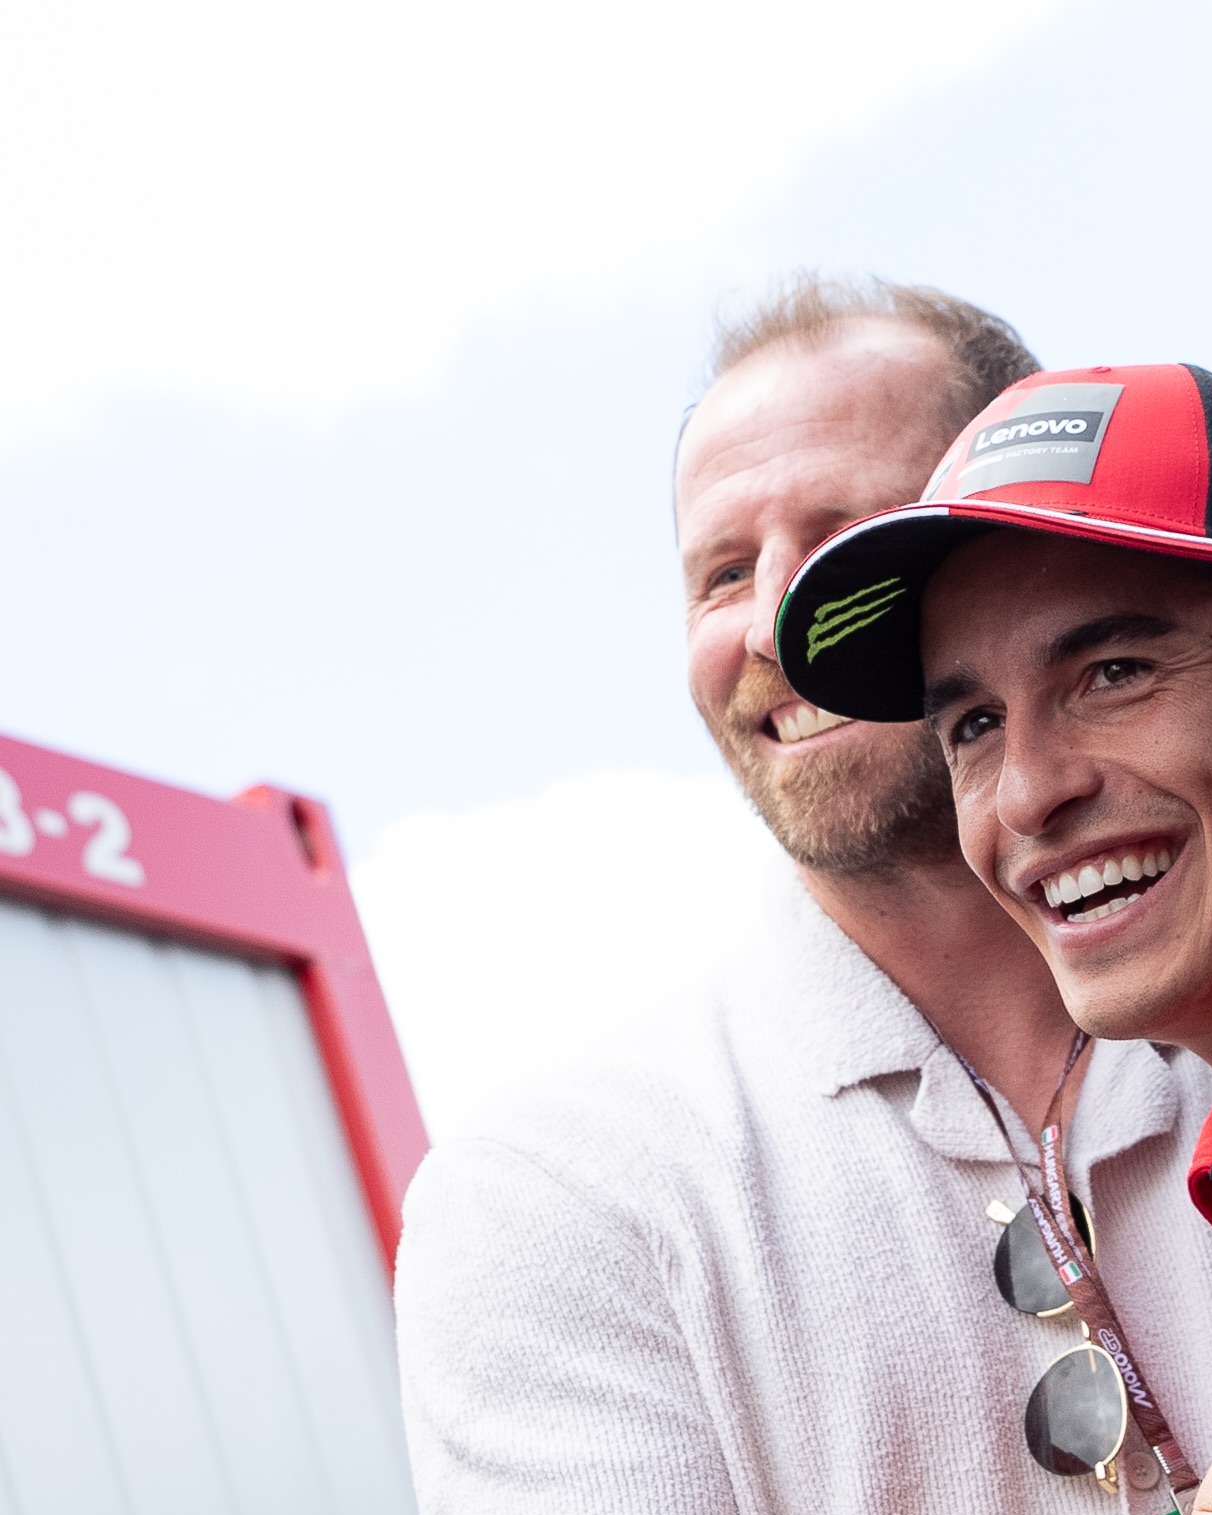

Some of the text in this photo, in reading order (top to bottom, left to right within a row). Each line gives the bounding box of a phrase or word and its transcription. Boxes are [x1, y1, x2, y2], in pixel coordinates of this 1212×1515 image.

[975, 419, 1088, 451] Lenovo
[1005, 446, 1079, 459] FACTORY TEAM
[1044, 1143, 1064, 1212] HUNGARY
